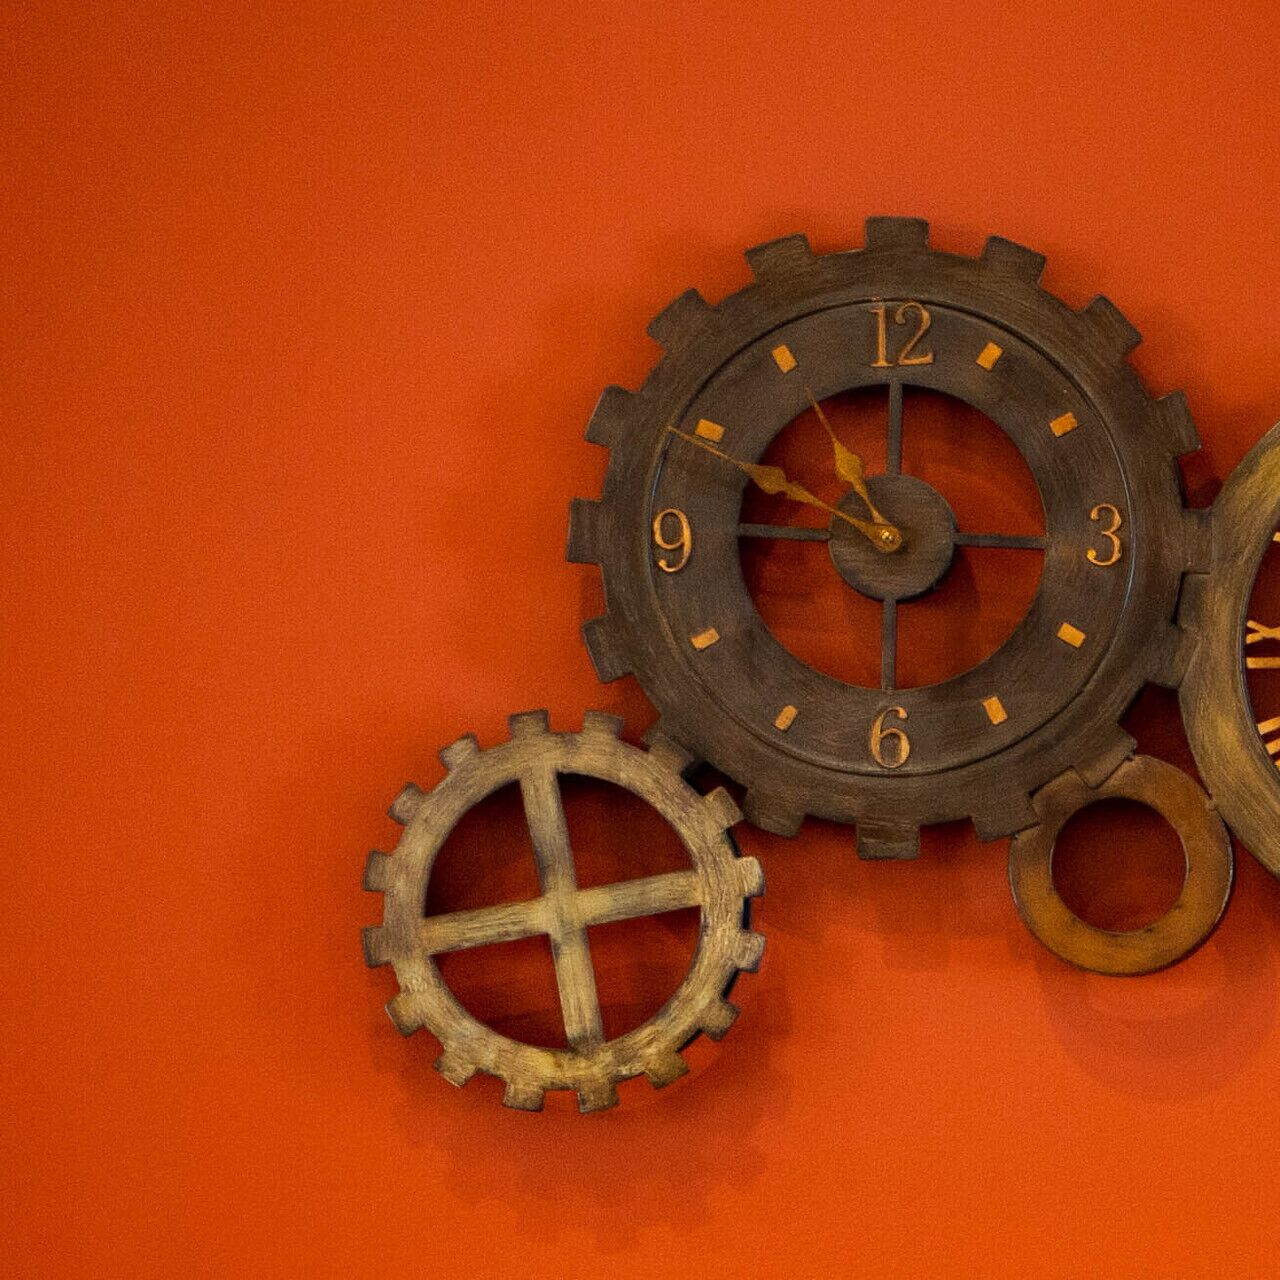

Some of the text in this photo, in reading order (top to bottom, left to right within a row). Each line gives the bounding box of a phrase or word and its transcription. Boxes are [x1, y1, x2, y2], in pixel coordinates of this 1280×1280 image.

[869, 300, 934, 368] 12
[652, 507, 693, 572] 9
[1085, 503, 1123, 566] 3
[870, 706, 910, 769] 6
